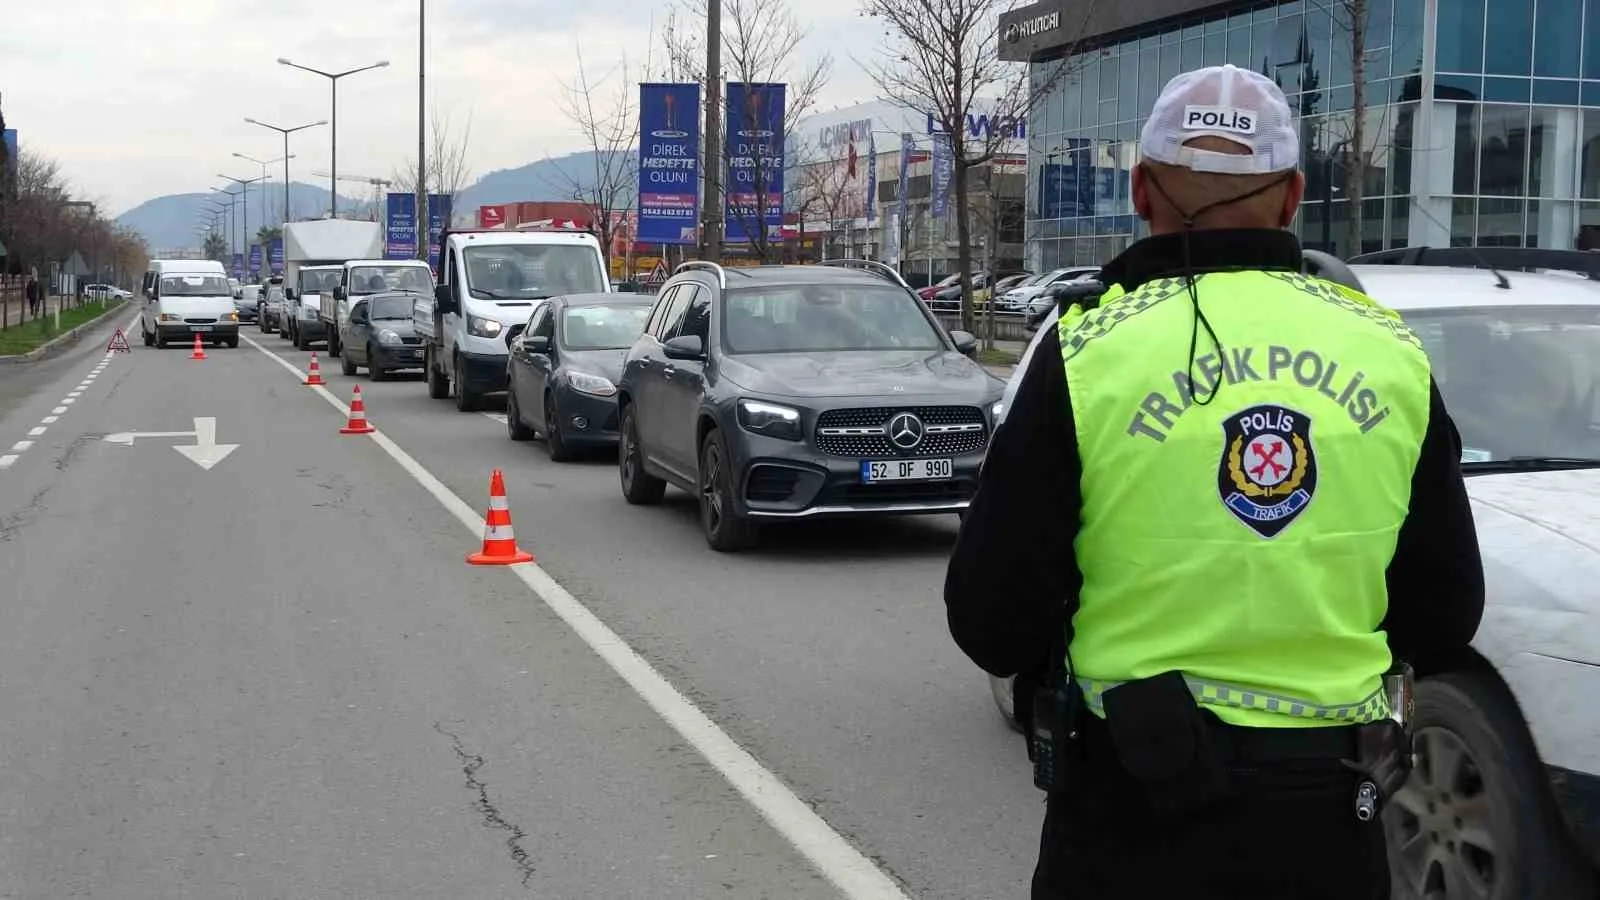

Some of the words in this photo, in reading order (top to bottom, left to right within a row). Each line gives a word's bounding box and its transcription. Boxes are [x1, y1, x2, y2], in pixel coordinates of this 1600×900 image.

[1020, 11, 1059, 38] HYUNDAI
[1188, 111, 1252, 130] POLİS
[652, 142, 687, 156] DİREK
[642, 156, 696, 169] HEDEFTE
[1127, 343, 1262, 443] TRAFİK
[1268, 345, 1390, 434] POLİSİ
[1239, 409, 1294, 436] POLİS
[871, 463, 887, 478] 52
[899, 462, 914, 477] DF
[926, 461, 949, 476] 990
[1253, 502, 1294, 519] TRAFİK
